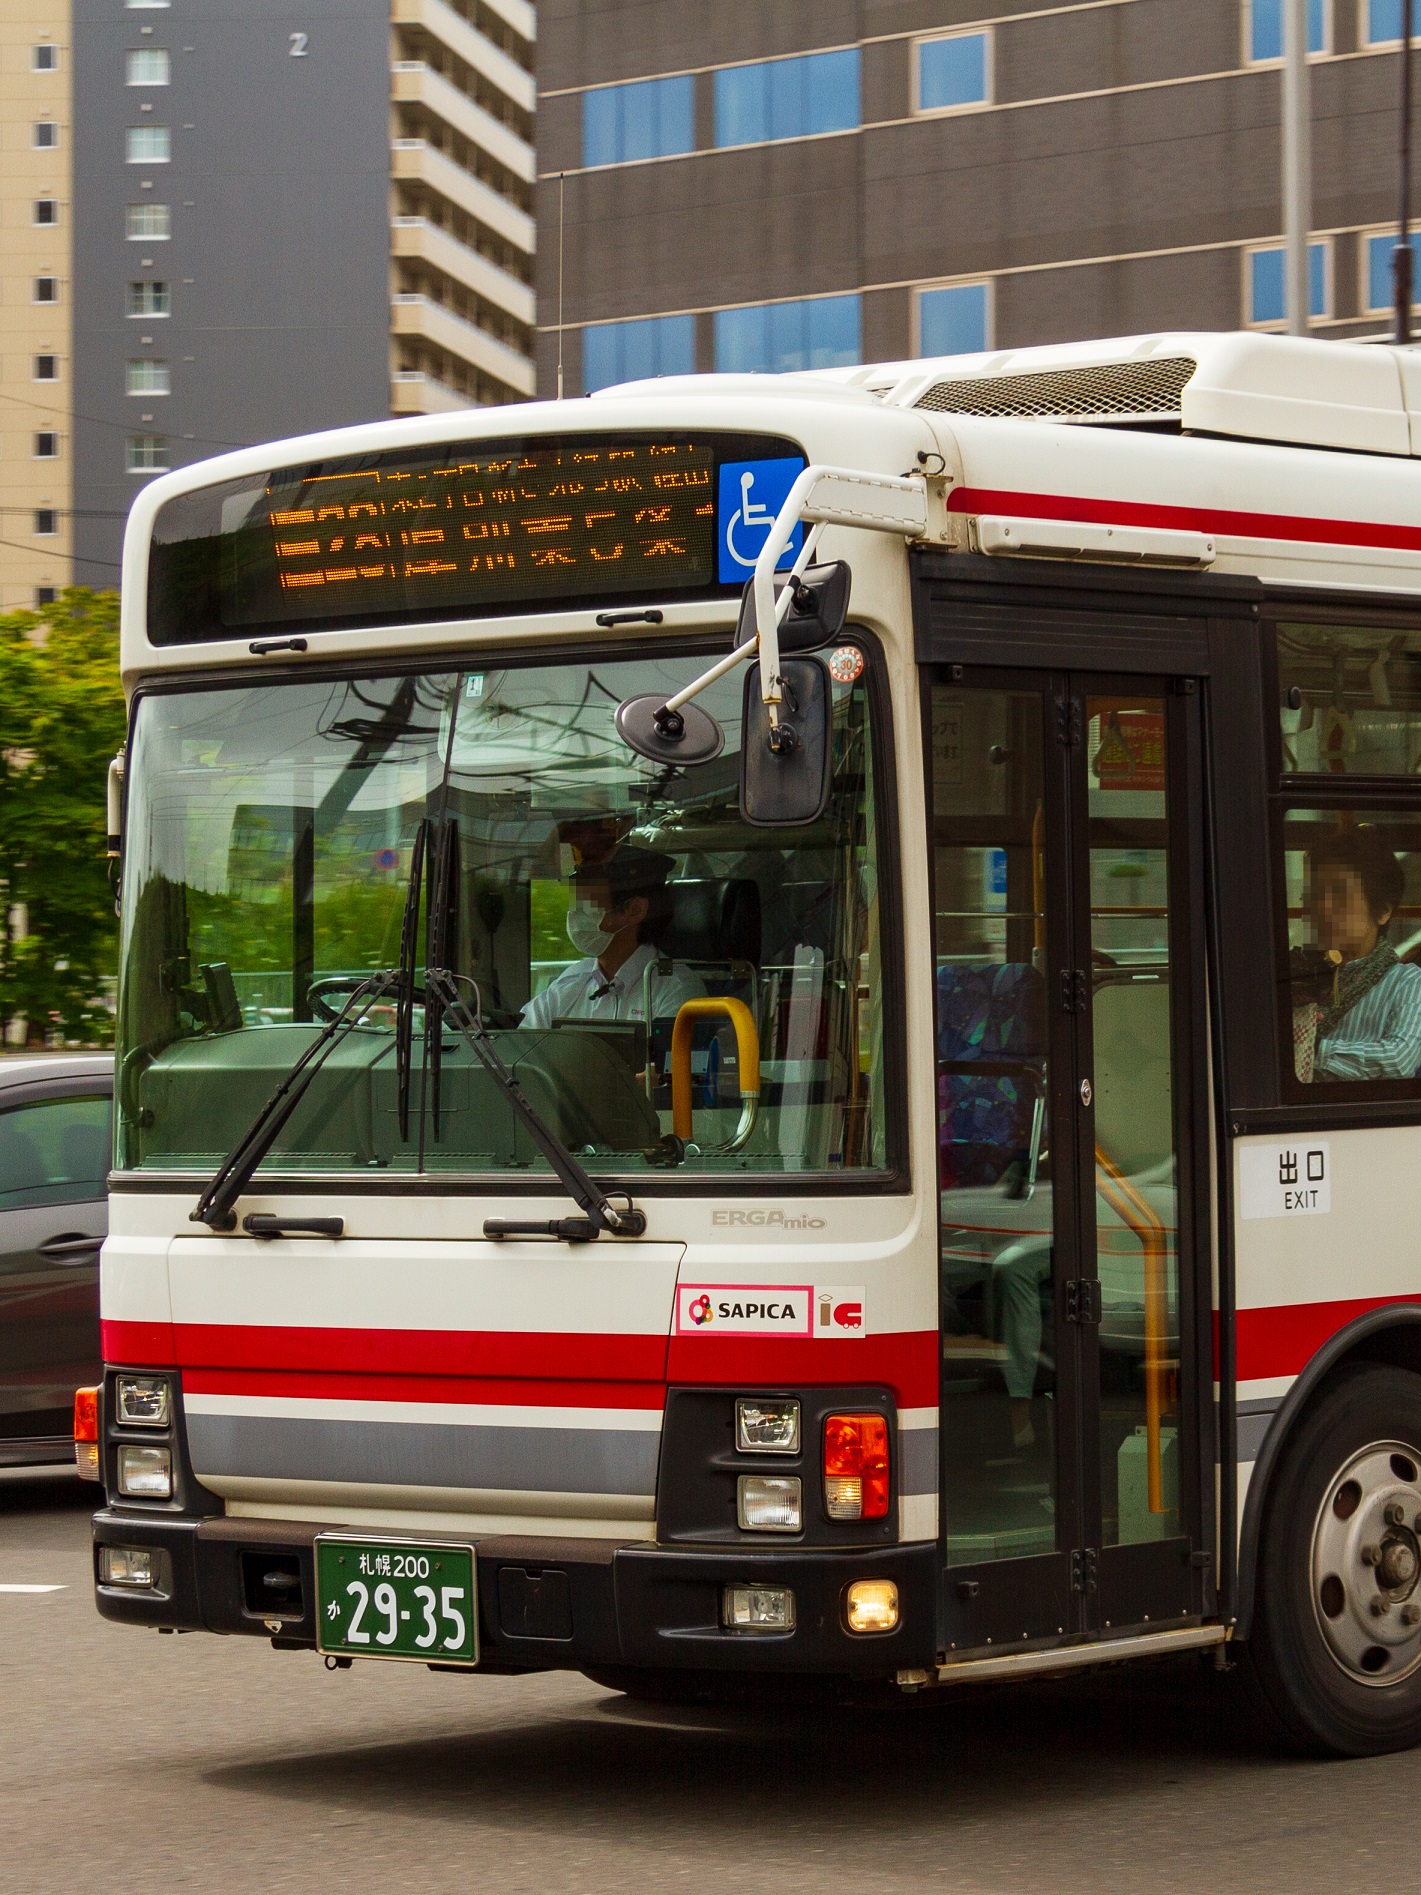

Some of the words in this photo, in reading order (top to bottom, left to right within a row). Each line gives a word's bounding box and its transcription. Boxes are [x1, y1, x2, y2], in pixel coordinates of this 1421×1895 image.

[288, 32, 309, 57] 2
[841, 659, 853, 670] 30
[1279, 1150, 1324, 1185] 出口
[1285, 1190, 1319, 1209] EXIT
[718, 1302, 796, 1320] SAPICA
[327, 1600, 341, 1620] か
[346, 1581, 466, 1650] 29-35
